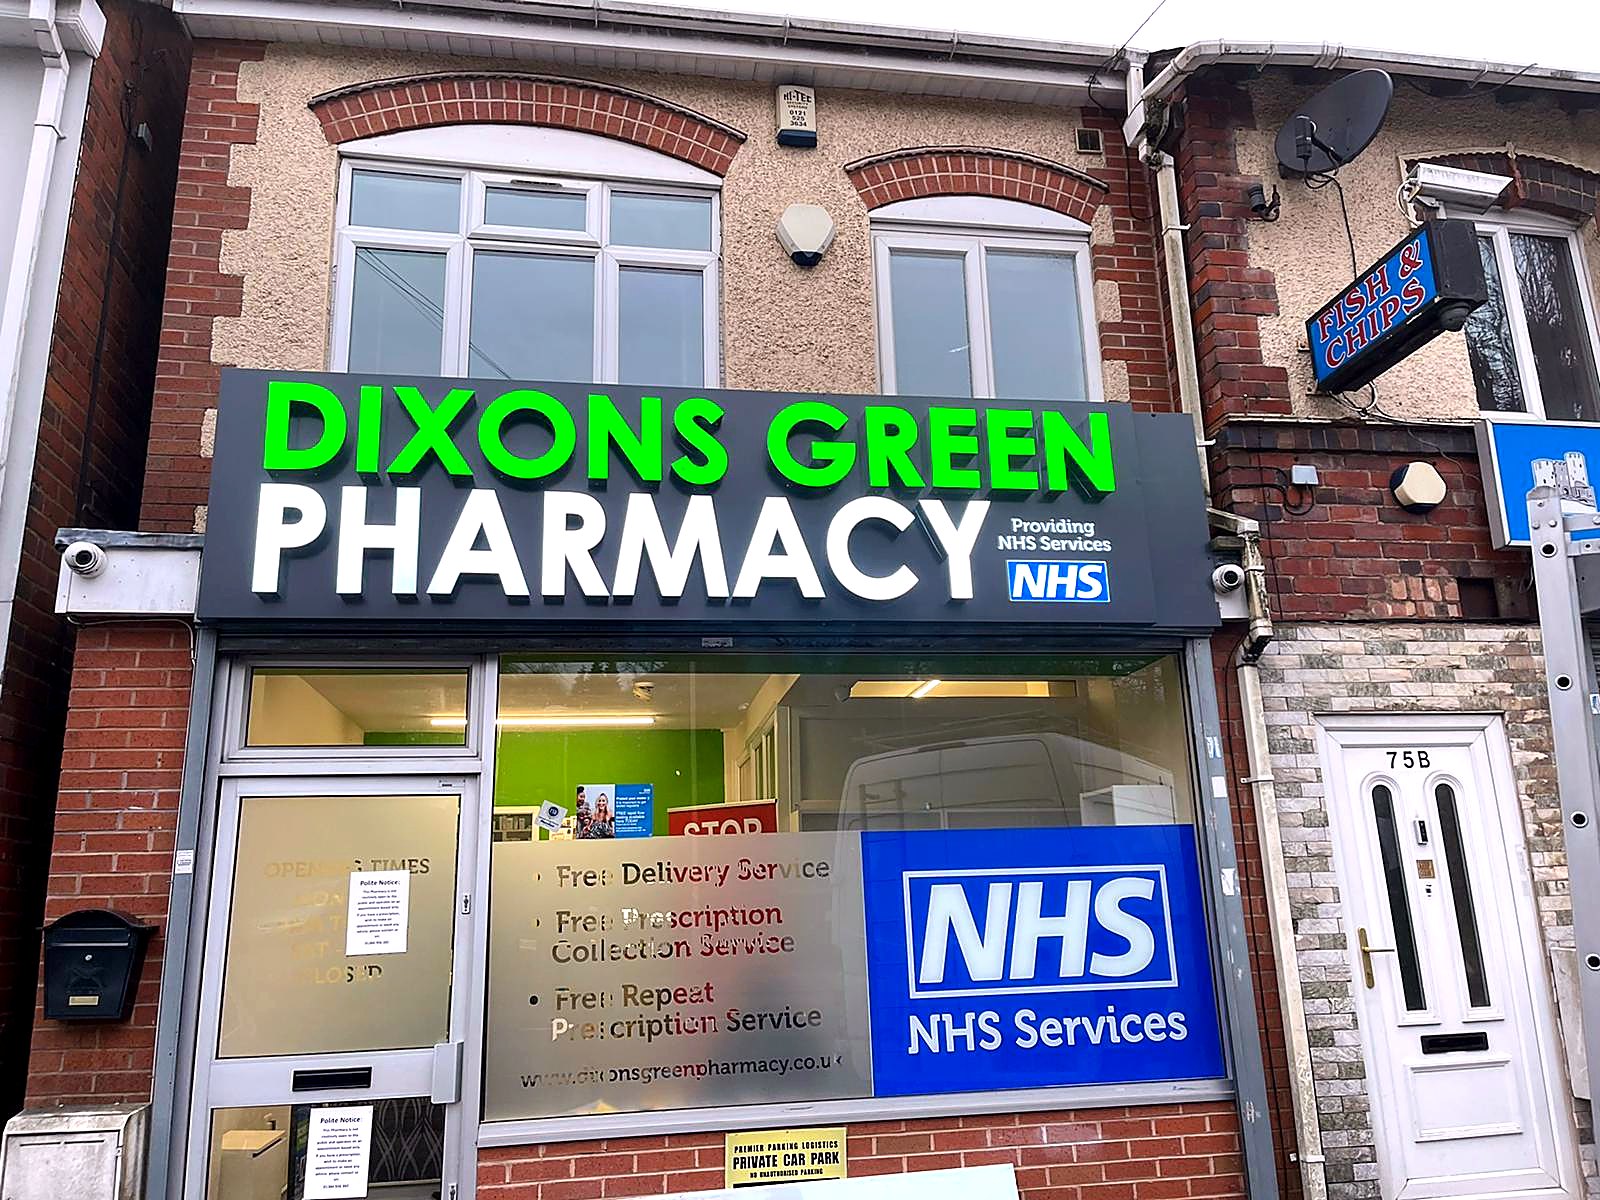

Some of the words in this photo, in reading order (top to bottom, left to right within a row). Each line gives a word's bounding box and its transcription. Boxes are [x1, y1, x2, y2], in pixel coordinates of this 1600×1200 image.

[1317, 264, 1391, 343] FISH
[1399, 239, 1423, 279] &
[1325, 277, 1426, 368] CHIPS
[263, 381, 729, 486] DIXONS
[766, 401, 1117, 493] GREEN
[251, 482, 991, 601] PHARMACY
[997, 535, 1037, 551] NHS
[1040, 536, 1112, 552] Services
[1011, 518, 1095, 539] Providing
[1011, 564, 1104, 600] NHS
[1386, 751, 1431, 769] 75B
[371, 858, 430, 875] TIMES
[622, 861, 731, 888] Delivery
[737, 858, 832, 882] Service
[621, 904, 783, 932] Prescription
[919, 877, 1156, 984] NHS
[552, 938, 691, 964] Collection
[700, 933, 797, 958] Service
[622, 981, 715, 1011] Repeat
[727, 1005, 823, 1032] Service
[908, 1010, 1002, 1055] NHS
[1014, 1005, 1188, 1049] Services
[733, 1154, 778, 1170] PRIVATE
[783, 1153, 806, 1167] CAR
[810, 1151, 840, 1165] PARK
[734, 1144, 764, 1153] PREMIER
[768, 1142, 798, 1151] PARKING
[802, 1141, 838, 1150] LOGISTICS
